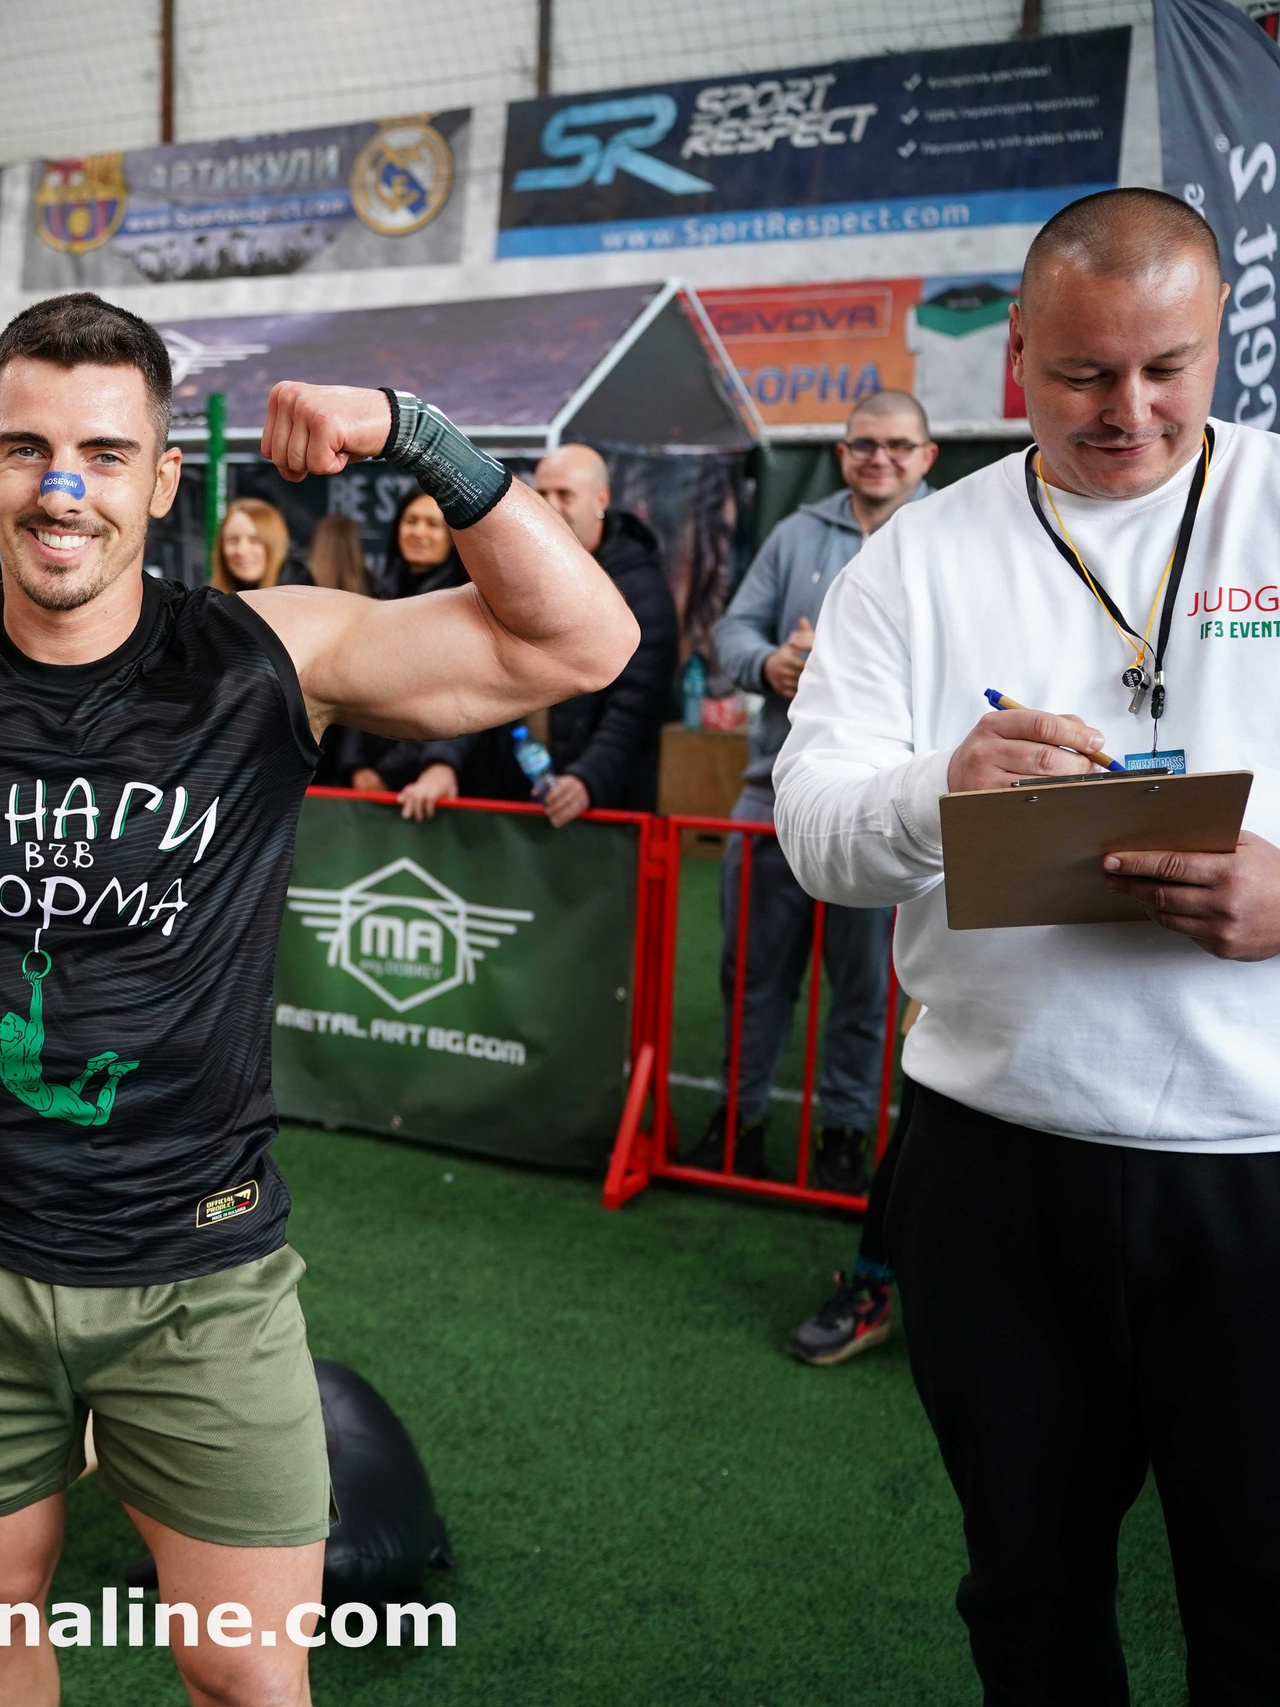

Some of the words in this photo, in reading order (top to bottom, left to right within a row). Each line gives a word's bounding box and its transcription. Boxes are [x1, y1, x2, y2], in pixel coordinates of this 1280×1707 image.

[692, 72, 838, 120] SPORT
[512, 92, 717, 196] SR
[680, 103, 880, 160] RESPECT
[148, 143, 342, 192] АРТИКУЛИ
[600, 202, 970, 250] www.SportRespect.com
[43, 477, 79, 489] NOSEWAY
[24, 840, 94, 872] ВЪВ
[360, 914, 444, 964] MA
[206, 1195, 234, 1208] OFFICIAL
[206, 1200, 236, 1214] PRODUCT
